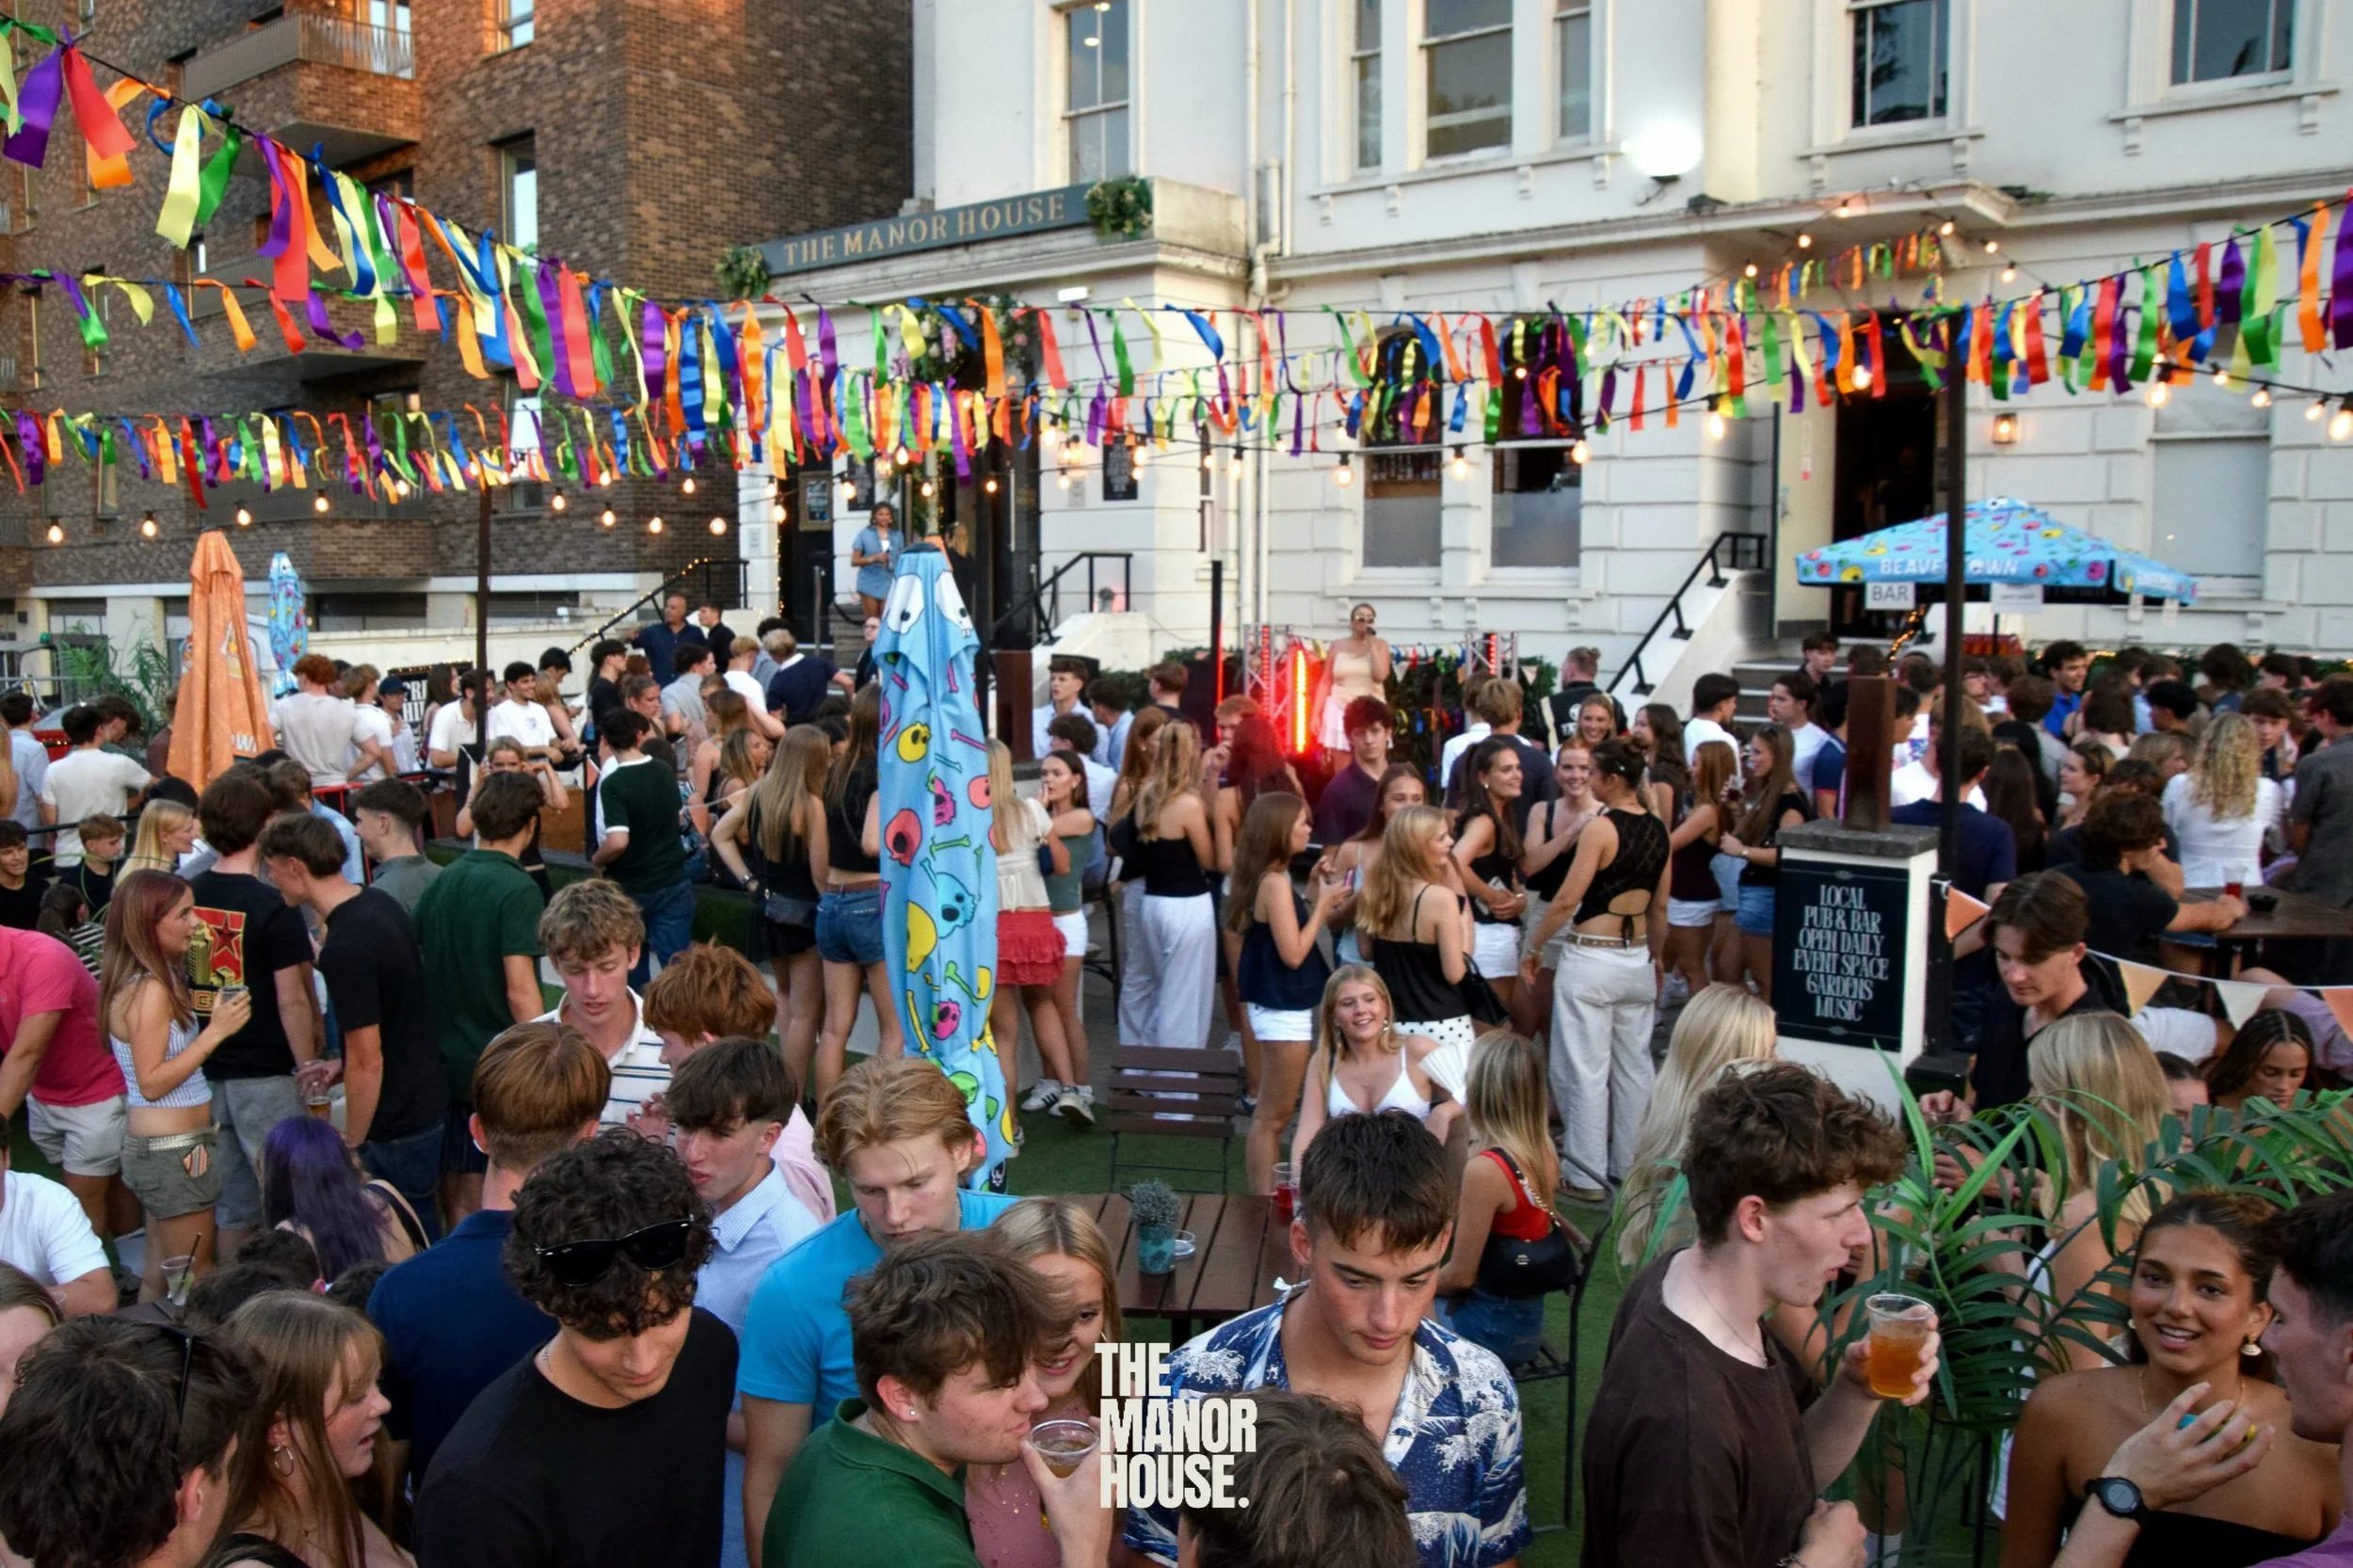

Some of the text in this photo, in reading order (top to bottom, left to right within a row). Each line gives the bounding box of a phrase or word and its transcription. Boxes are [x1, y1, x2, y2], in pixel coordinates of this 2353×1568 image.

[783, 194, 1065, 266] THE MANOR HOUSE
[1870, 584, 1909, 601] BAR
[1819, 884, 1867, 910] LOCAL
[1803, 905, 1882, 935] PUB & BAR
[1799, 928, 1885, 957] OPEN DAILY
[1793, 949, 1890, 981] EVENT SPACE
[1805, 972, 1874, 1001] GARDENS
[1815, 995, 1864, 1022] MUSIC
